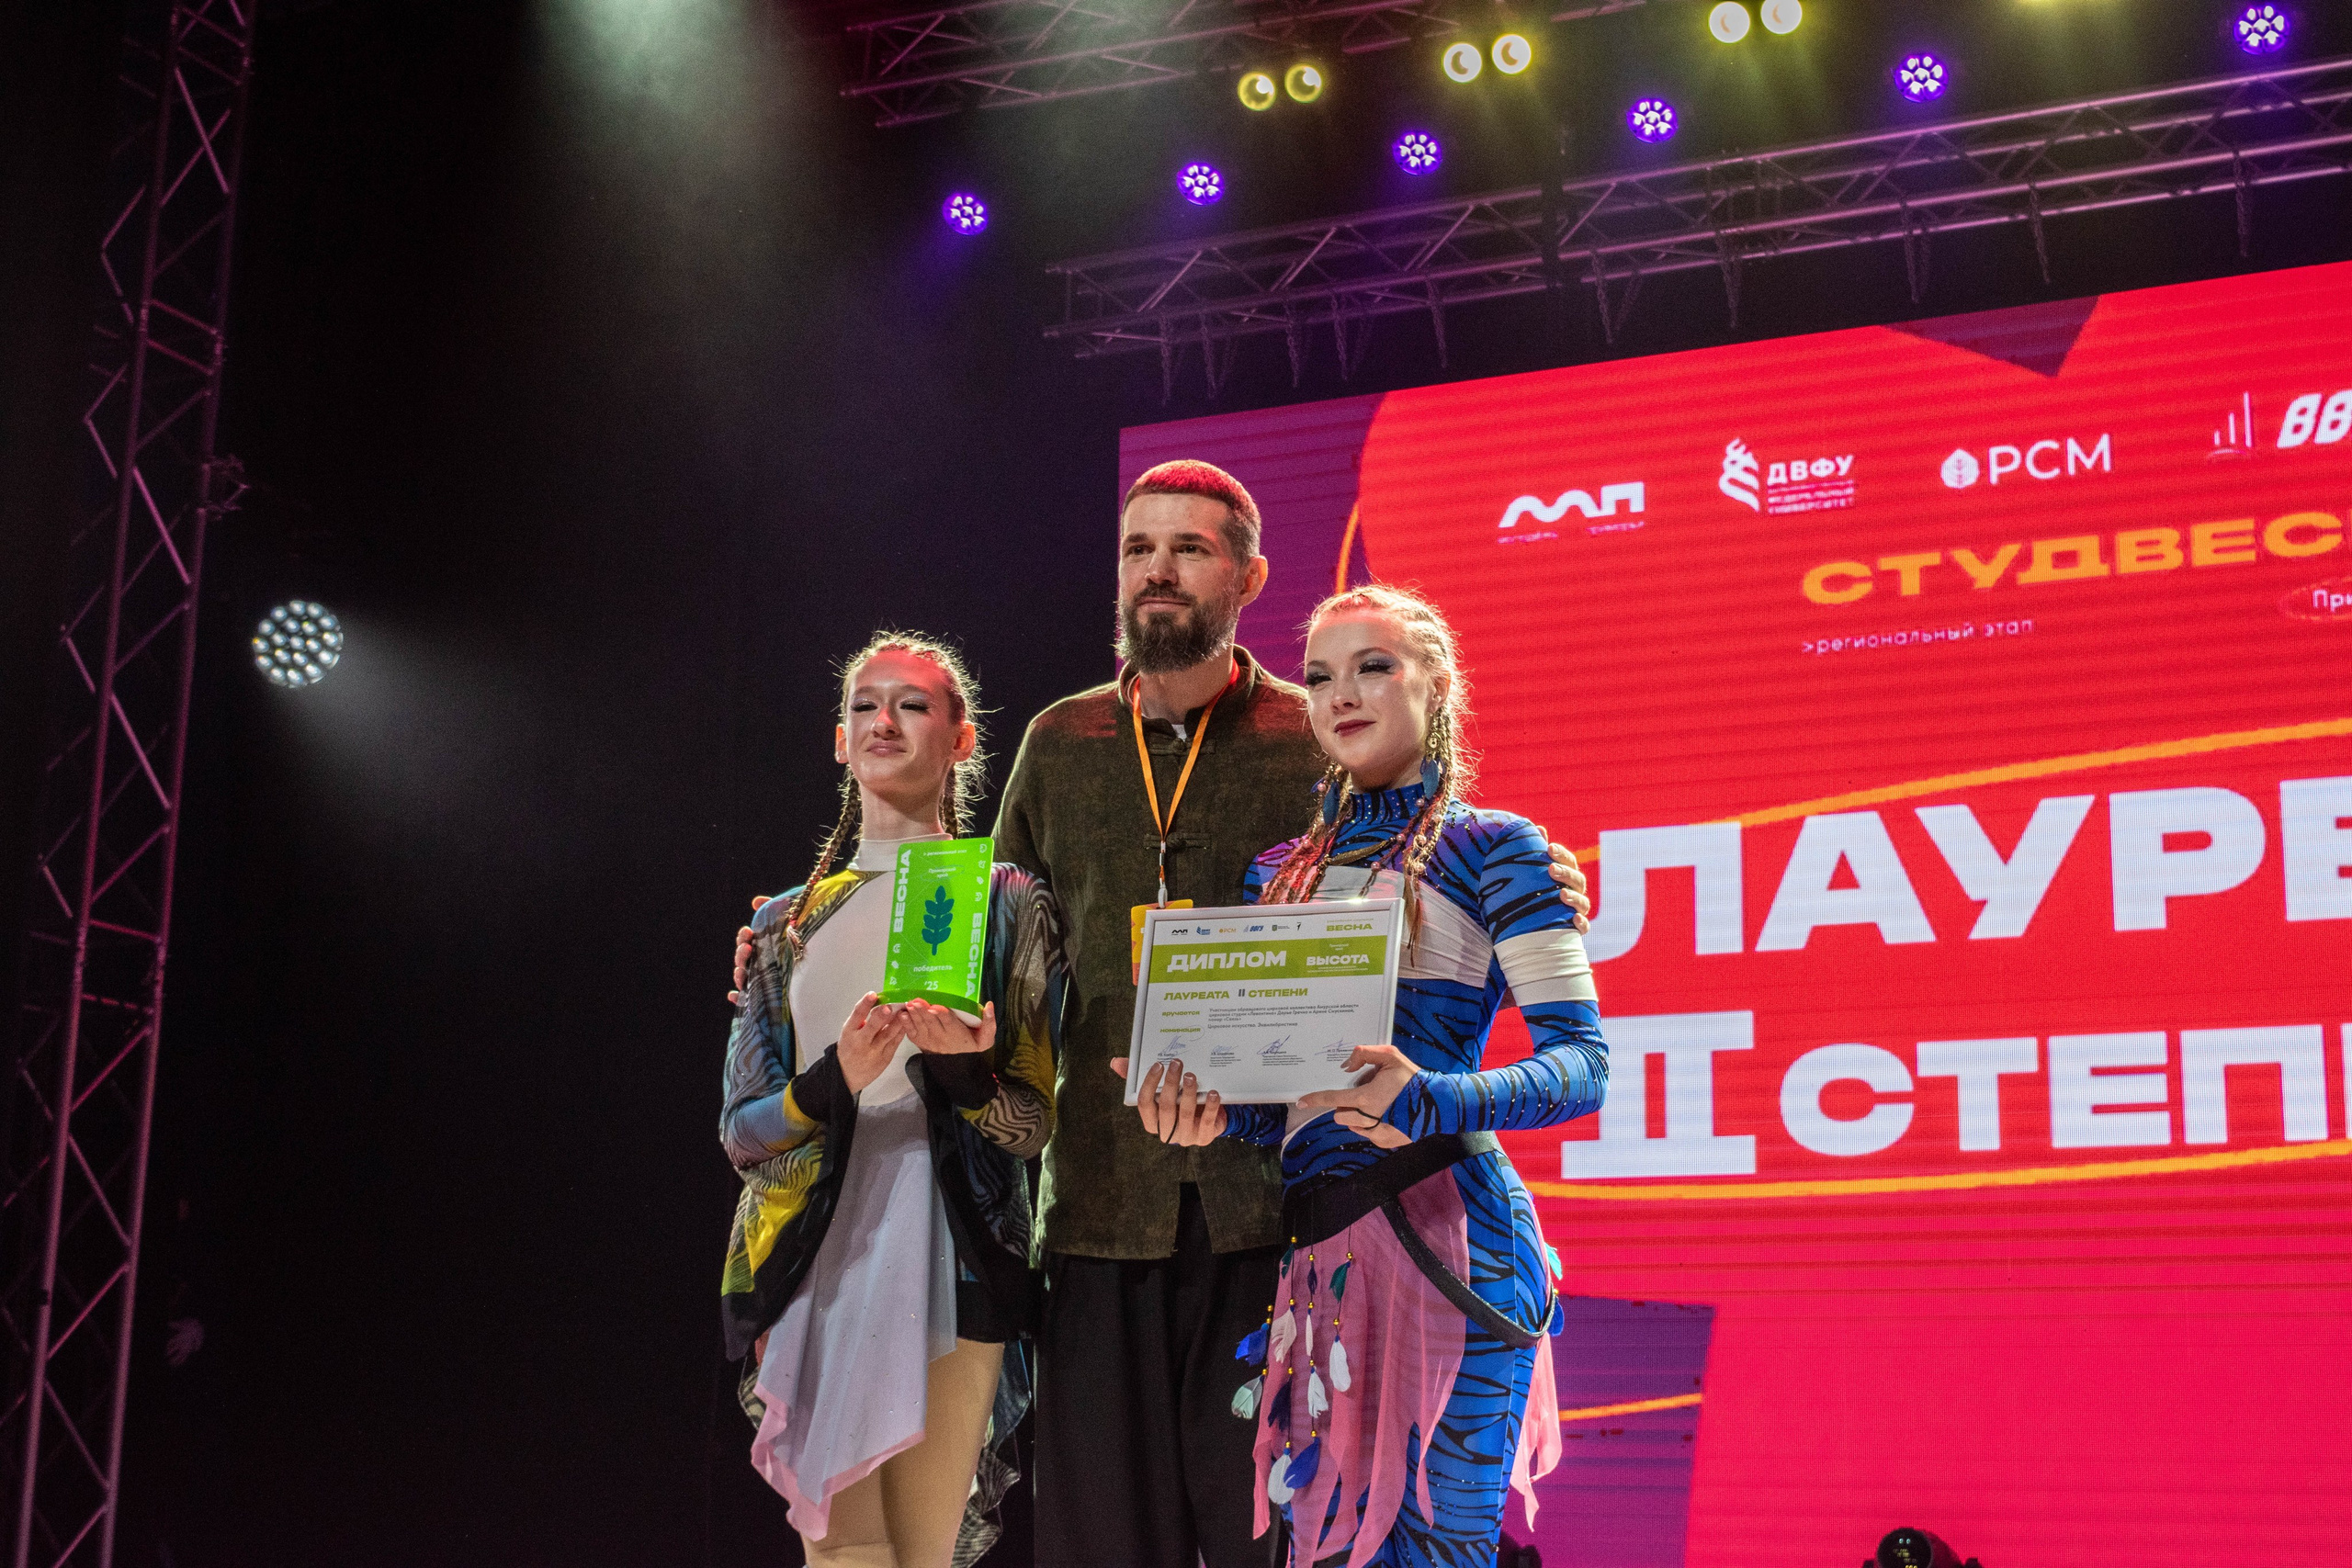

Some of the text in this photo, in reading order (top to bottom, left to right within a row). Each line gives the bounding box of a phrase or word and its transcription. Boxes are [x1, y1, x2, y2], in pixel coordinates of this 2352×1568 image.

[1767, 455, 1854, 486] ДВФУ
[1989, 434, 2111, 485] РСМ
[1801, 508, 2352, 604] СТУДВЕС
[1984, 619, 2033, 637] этап
[893, 849, 911, 933] ВЕСНА
[1327, 923, 1373, 931] ВЕСНА
[966, 912, 983, 998] ВЕСНА
[1167, 951, 1286, 973] ДИПЛОМ
[1306, 954, 1370, 965] ВЫСОТА
[913, 964, 953, 973] победитель
[1164, 991, 1229, 1000] ЛАУРЕАТА
[1248, 988, 1308, 998] СТЕПЕНИ
[1780, 1022, 2352, 1157] СТЕП
